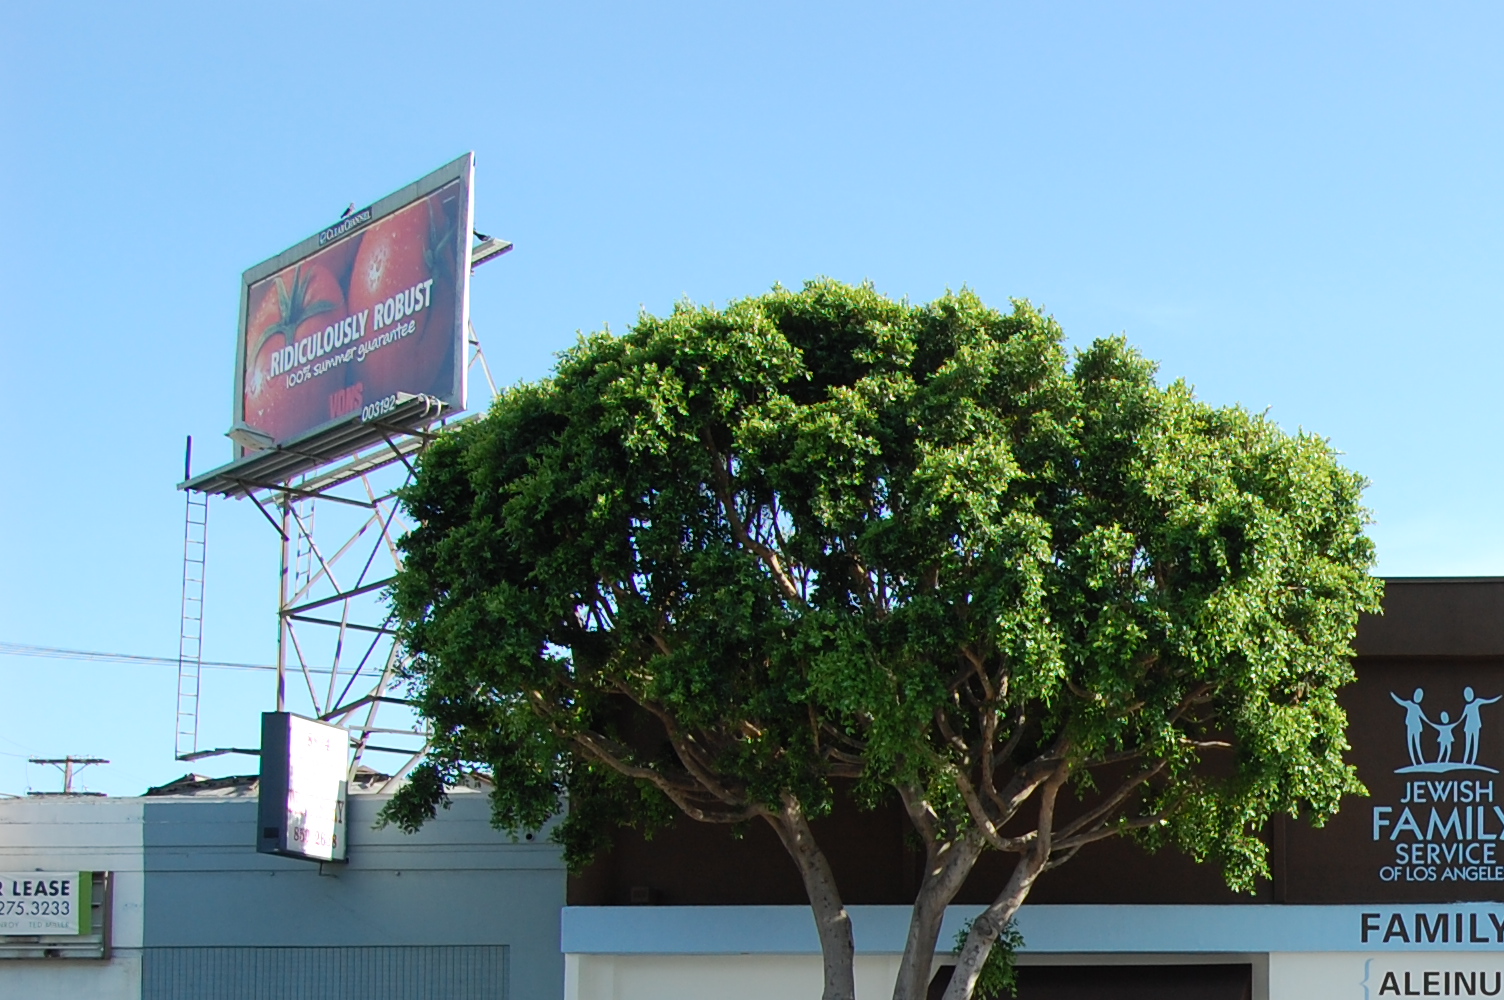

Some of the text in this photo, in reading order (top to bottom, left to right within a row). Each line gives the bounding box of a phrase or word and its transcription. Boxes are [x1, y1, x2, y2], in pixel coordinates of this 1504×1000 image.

[270, 279, 433, 377] RIDICULOUSLY ROBUST
[286, 319, 416, 389] 100% summer guarantee
[362, 394, 396, 422] 003192
[1400, 780, 1493, 803] JEWISH
[1395, 842, 1497, 865] SERVICE
[1379, 866, 1402, 881] OF
[1406, 866, 1437, 881] LOS
[12, 880, 70, 896] LEASE
[0, 900, 70, 915] 275.3233
[1379, 971, 1502, 996] ALEINU
